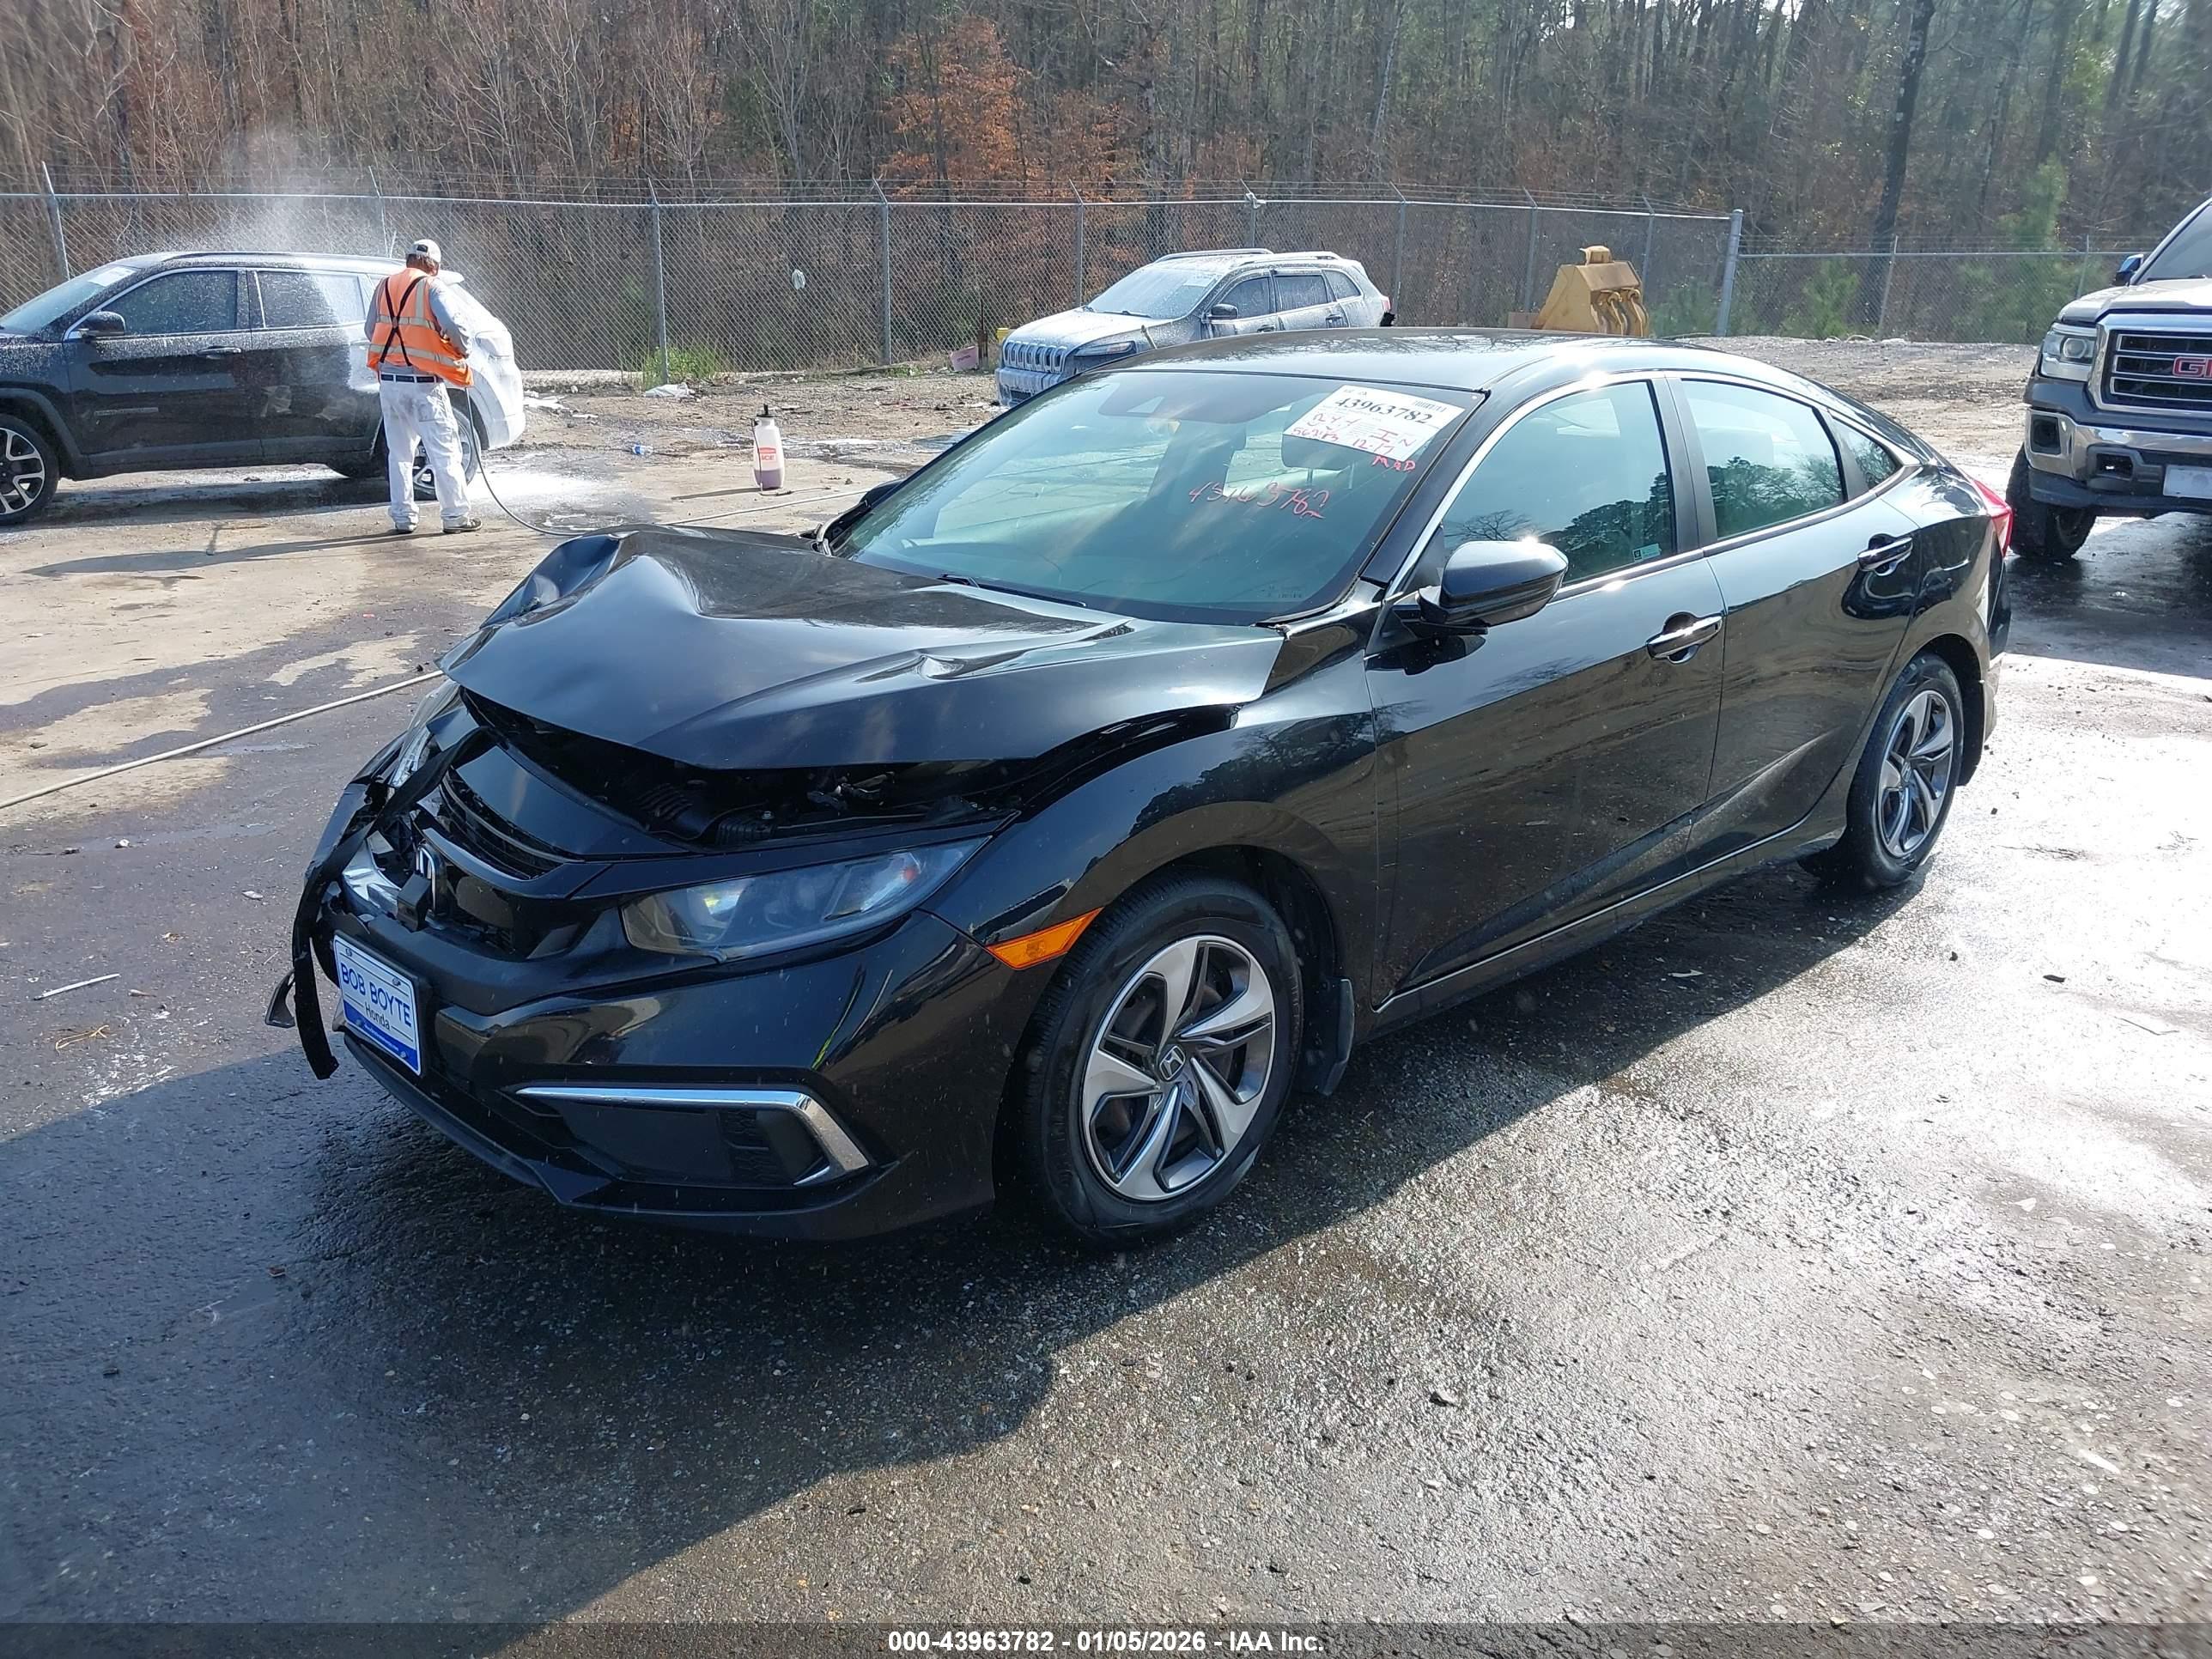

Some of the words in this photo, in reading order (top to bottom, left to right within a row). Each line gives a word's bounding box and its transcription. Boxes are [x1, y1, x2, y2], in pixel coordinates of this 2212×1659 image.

[2172, 356, 2212, 378] G
[1335, 398, 1433, 423] 43963782
[340, 963, 366, 996] BOB
[369, 981, 412, 1027] BOYTE
[364, 1002, 391, 1030] Honda
